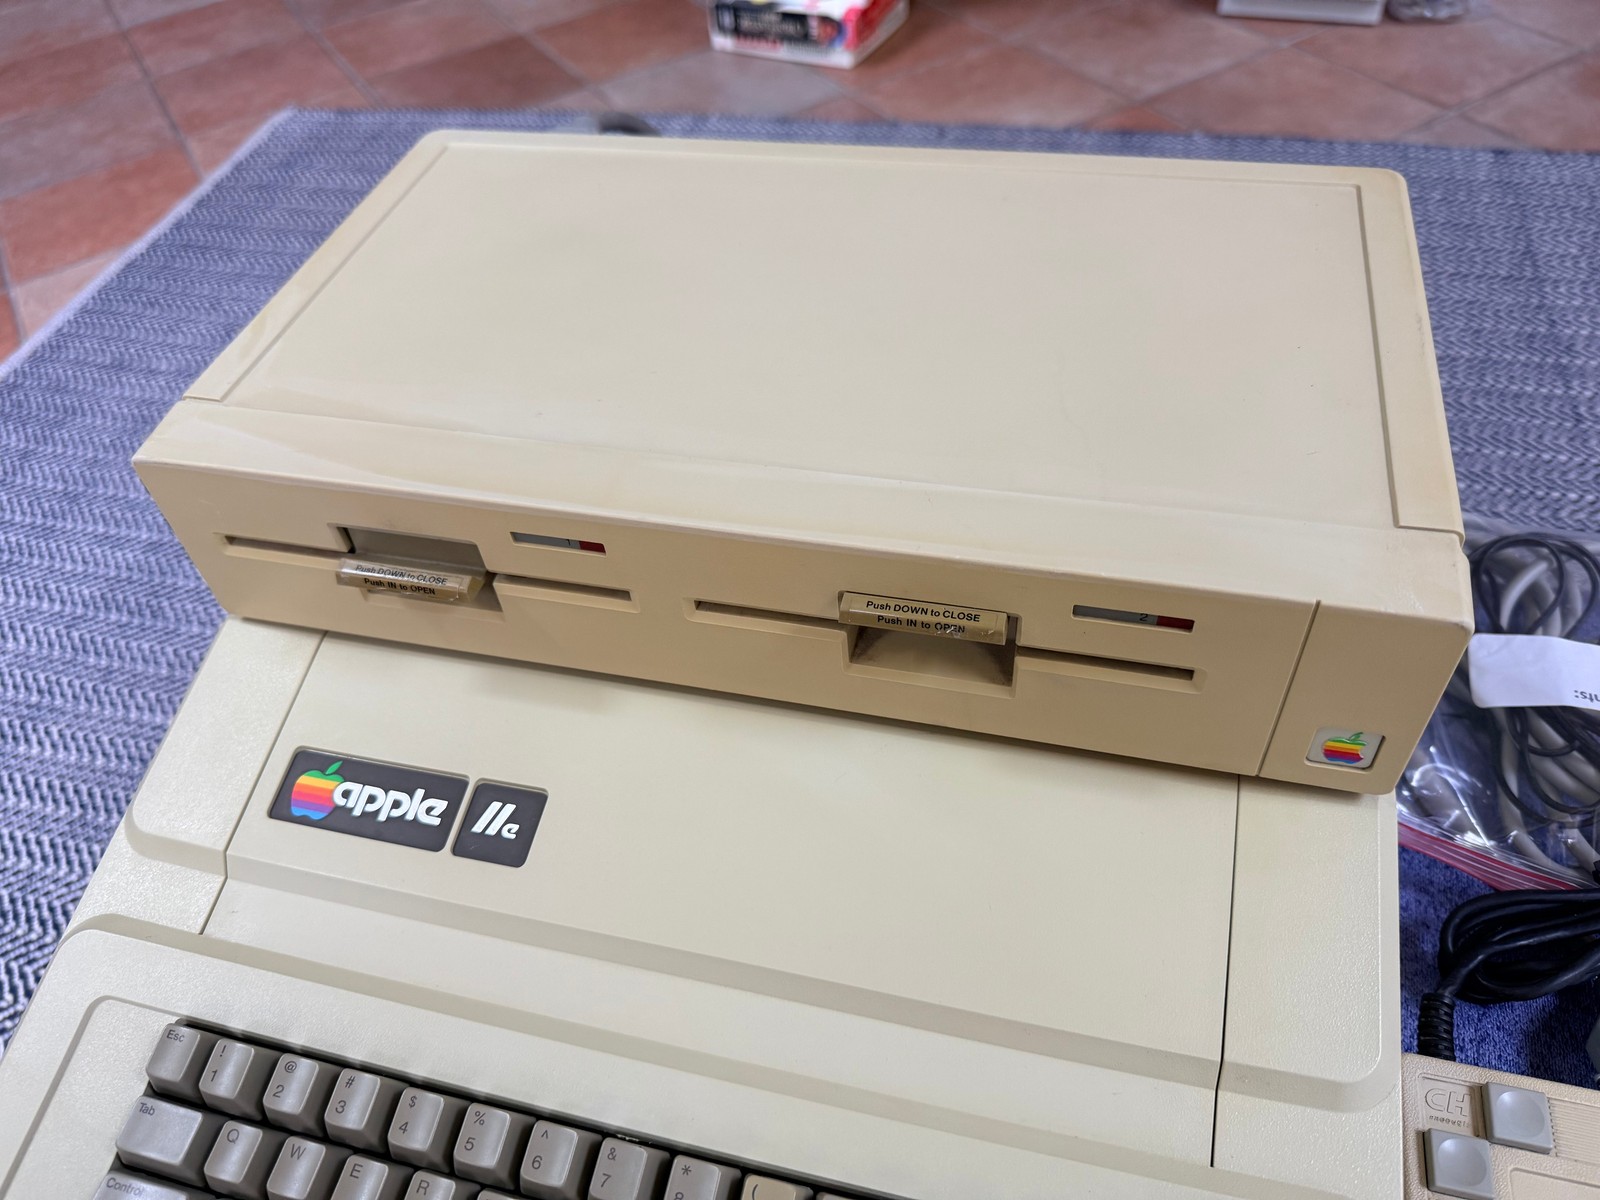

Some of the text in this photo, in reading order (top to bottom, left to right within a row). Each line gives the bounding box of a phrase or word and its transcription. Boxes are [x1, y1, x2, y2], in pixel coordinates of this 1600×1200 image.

[355, 564, 376, 574] Push
[376, 567, 406, 579] DOWN
[416, 574, 449, 585] CLOSE
[363, 577, 385, 588] Push
[387, 581, 397, 589] IN
[410, 585, 436, 595] OPEN
[866, 600, 981, 622] Push DOWN to CLOSE
[1139, 612, 1149, 623] 2
[877, 615, 965, 633] Push IN to OPEN
[332, 781, 449, 827] apple
[166, 1029, 185, 1044] Esc
[220, 1044, 227, 1058] !
[284, 1060, 298, 1074] @
[210, 1069, 218, 1082] 1
[344, 1075, 357, 1089] #
[272, 1084, 285, 1099] 2
[335, 1100, 347, 1115] 3
[408, 1094, 418, 1109] $
[1425, 1087, 1472, 1117] CH
[139, 1102, 156, 1117] Tab
[474, 1110, 486, 1126] %
[398, 1121, 409, 1135] 4
[227, 1128, 241, 1146] Q
[464, 1137, 475, 1151] 5
[290, 1143, 306, 1160] W
[607, 1147, 617, 1161] &
[531, 1155, 543, 1170] 6
[349, 1163, 364, 1179] E
[106, 1177, 145, 1197] Control
[416, 1180, 430, 1195] R
[601, 1173, 612, 1188] 7
